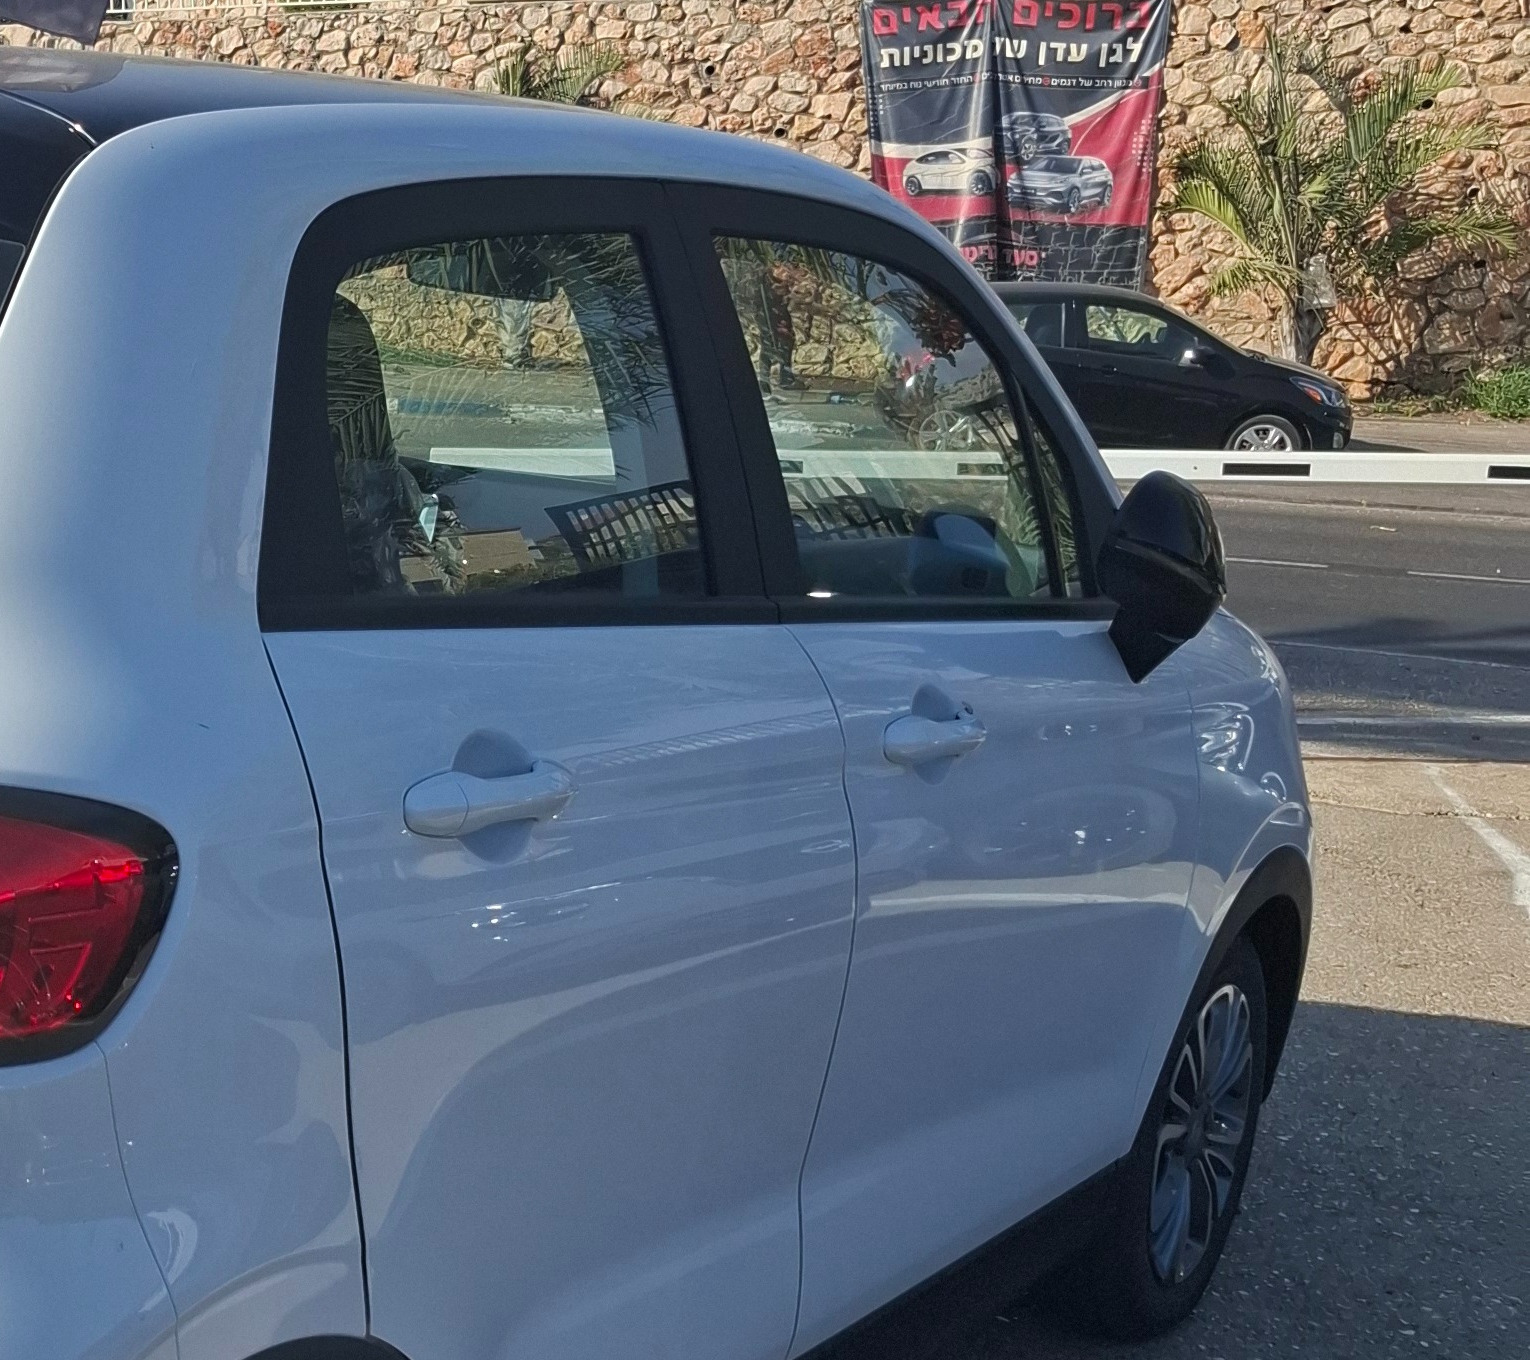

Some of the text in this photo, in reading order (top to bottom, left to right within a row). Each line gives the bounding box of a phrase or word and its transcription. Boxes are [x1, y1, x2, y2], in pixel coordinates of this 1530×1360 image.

[880, 36, 984, 68] מכוניות
[1038, 40, 1088, 66] עדן
[1099, 37, 1144, 67] לגן
[951, 75, 973, 85] החזר
[1051, 78, 1077, 87] דגמים
[1079, 77, 1093, 86] של
[1094, 79, 1113, 87] רחב
